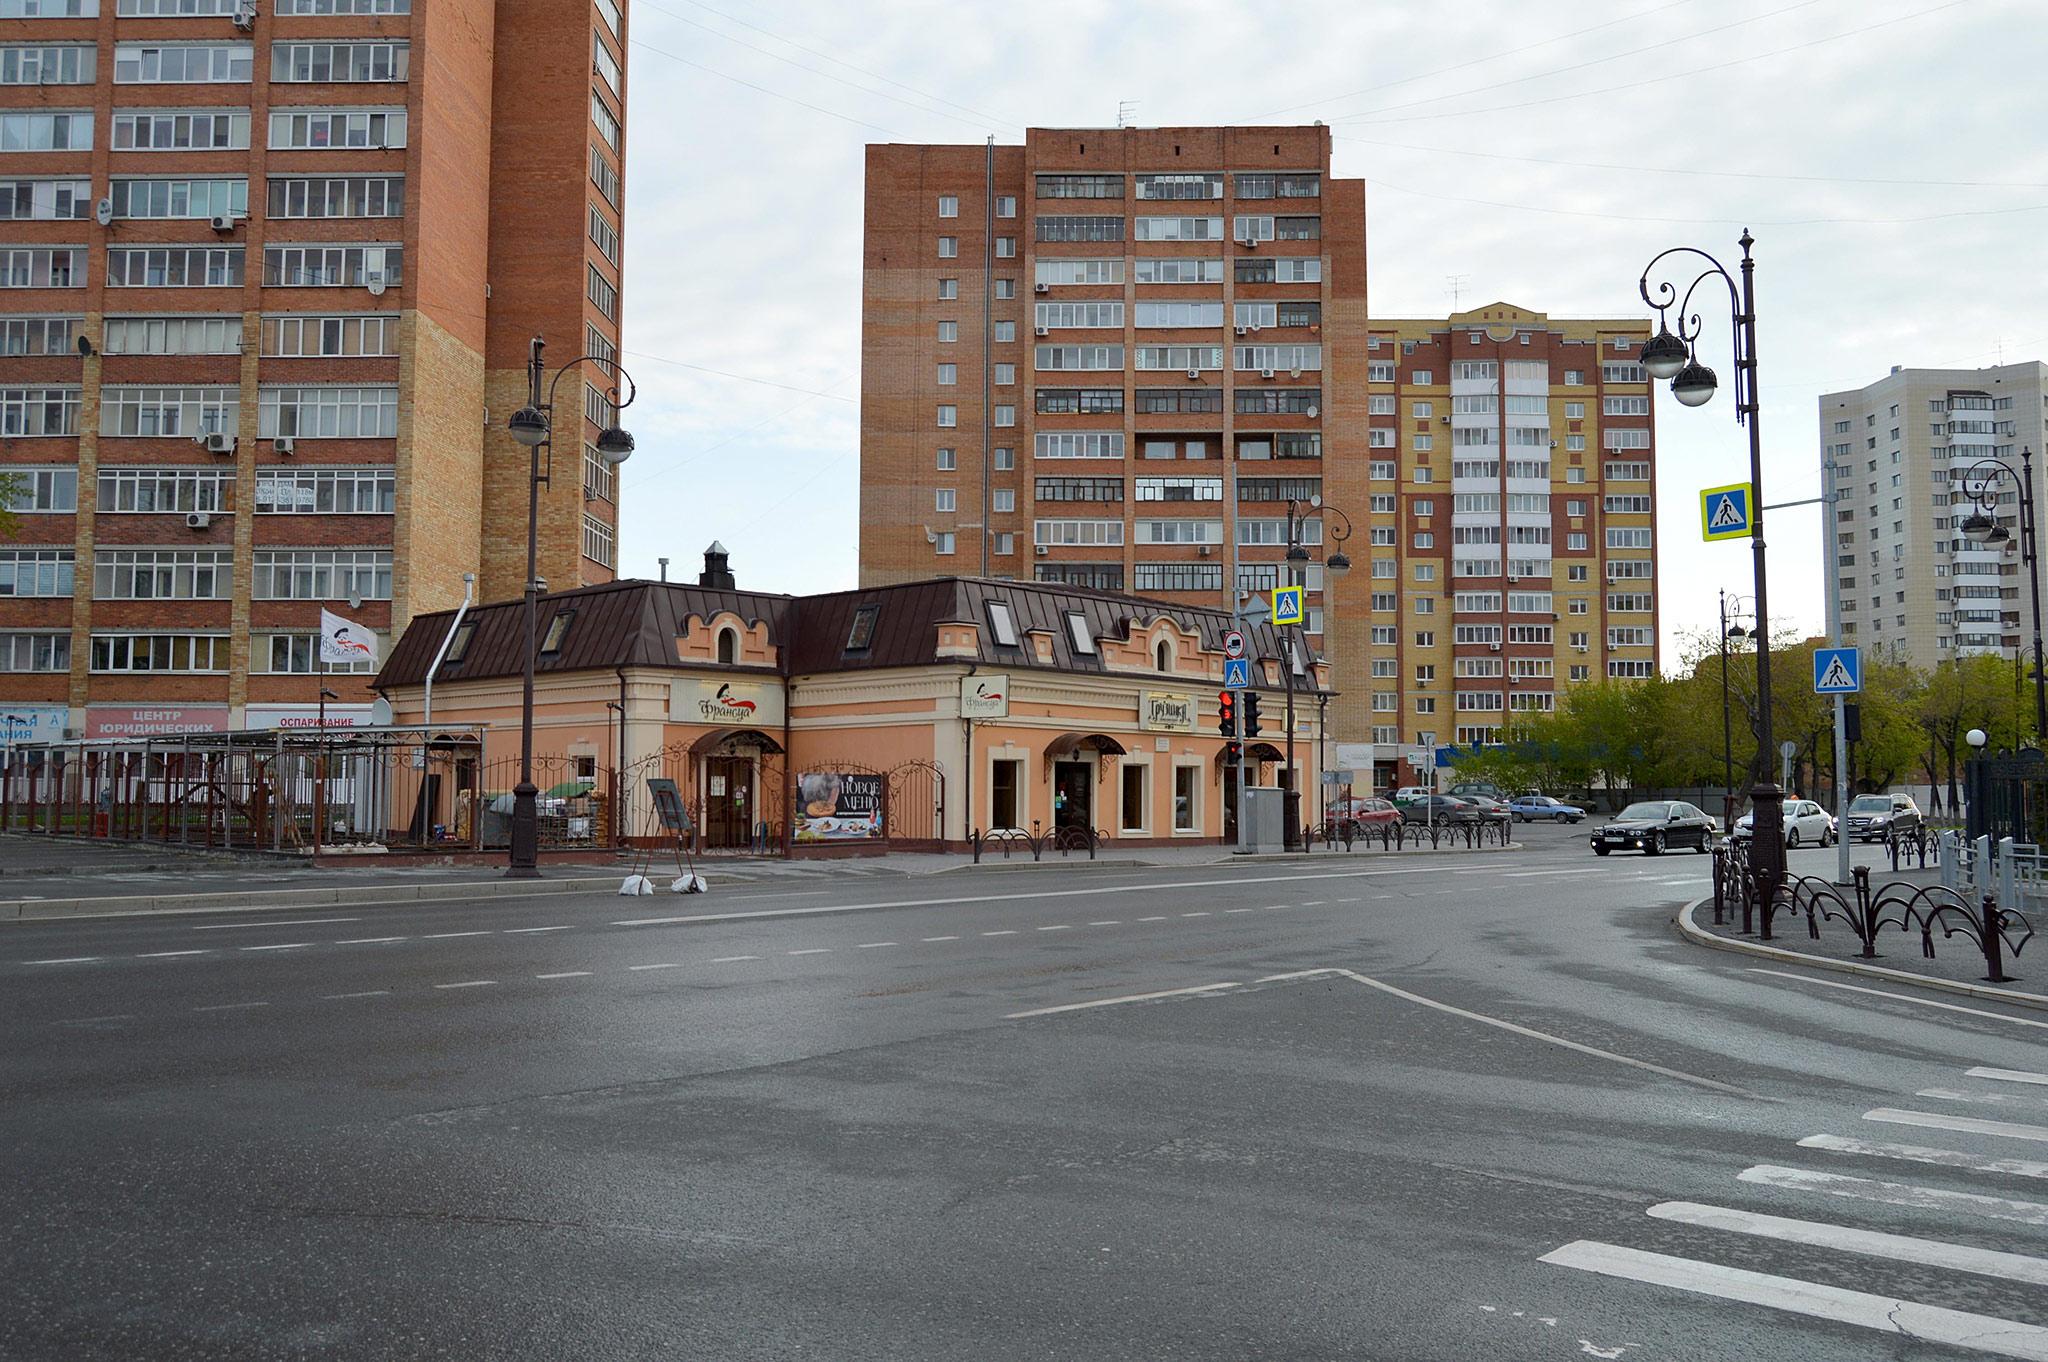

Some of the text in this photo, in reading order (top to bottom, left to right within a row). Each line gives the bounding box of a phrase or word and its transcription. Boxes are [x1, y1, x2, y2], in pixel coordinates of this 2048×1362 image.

[133, 711, 182, 721] ЦЕНТР
[698, 699, 750, 722] Франсуа
[100, 723, 214, 735] ЮРИДИЧЕСКИХ
[841, 781, 880, 795] НОВОЕ
[844, 796, 879, 809] МЕНЮ
